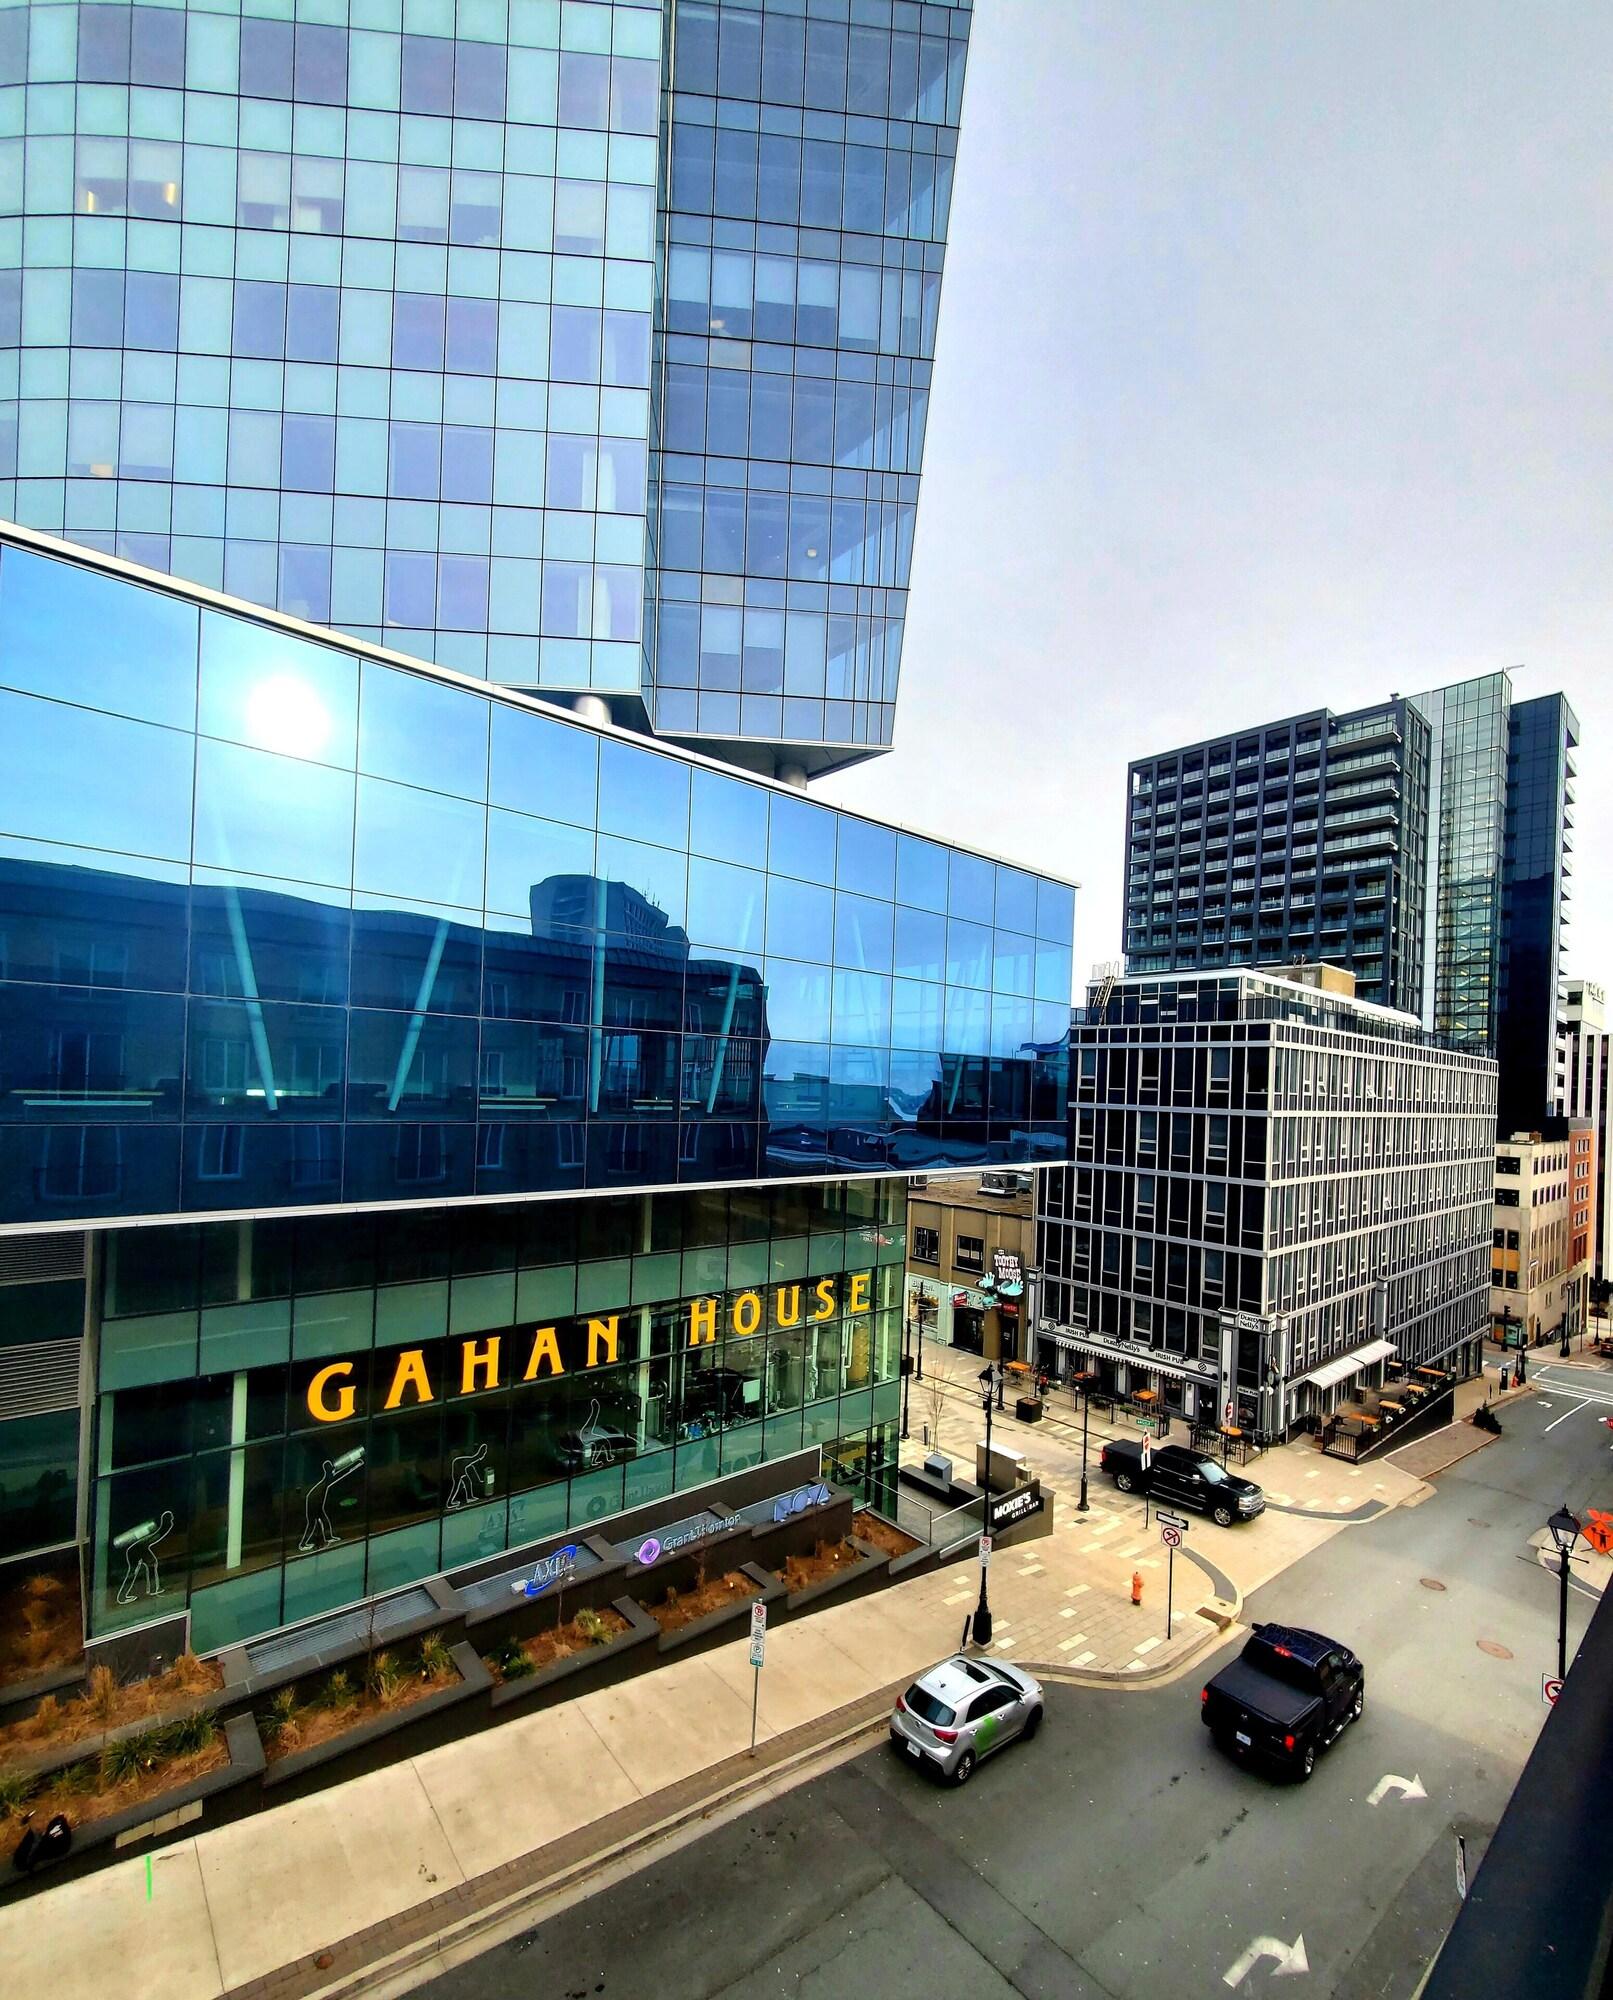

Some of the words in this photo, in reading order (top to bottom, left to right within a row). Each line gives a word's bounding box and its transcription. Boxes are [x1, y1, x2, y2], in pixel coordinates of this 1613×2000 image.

[994, 1255, 1018, 1267] TOOTHY
[998, 1267, 1021, 1281] MOOSE
[1065, 1327, 1079, 1336] IRISH
[307, 1316, 619, 1422] GAHAN
[689, 1273, 871, 1347] HOUSE
[1155, 1352, 1171, 1361] IRISH
[1171, 1356, 1184, 1365] PUB
[993, 1491, 1031, 1520] MOXIE'S
[1011, 1507, 1027, 1519] GRILL
[1029, 1500, 1040, 1510] BAR
[662, 1529, 698, 1551] Grant
